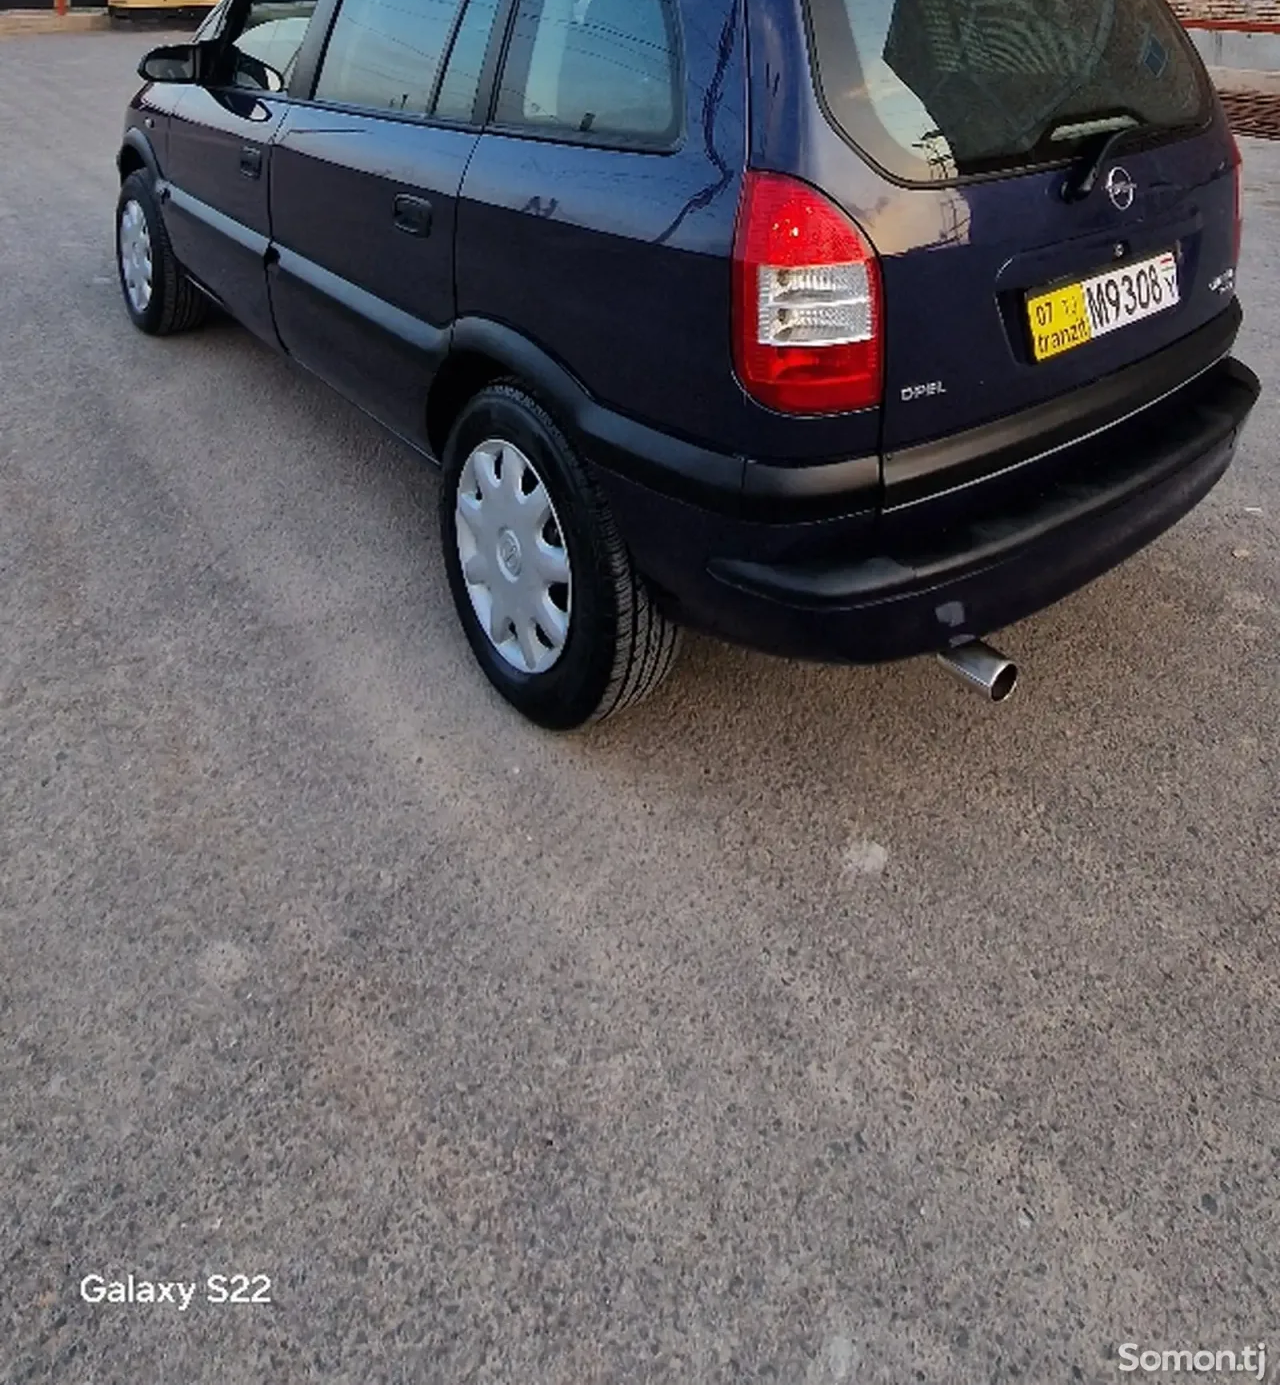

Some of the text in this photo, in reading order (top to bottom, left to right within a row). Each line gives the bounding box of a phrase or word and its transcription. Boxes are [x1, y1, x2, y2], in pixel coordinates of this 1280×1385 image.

[1036, 301, 1052, 326] 07
[1086, 264, 1162, 329] M9308
[1038, 317, 1089, 353] tranzit
[901, 380, 947, 400] OPEL
